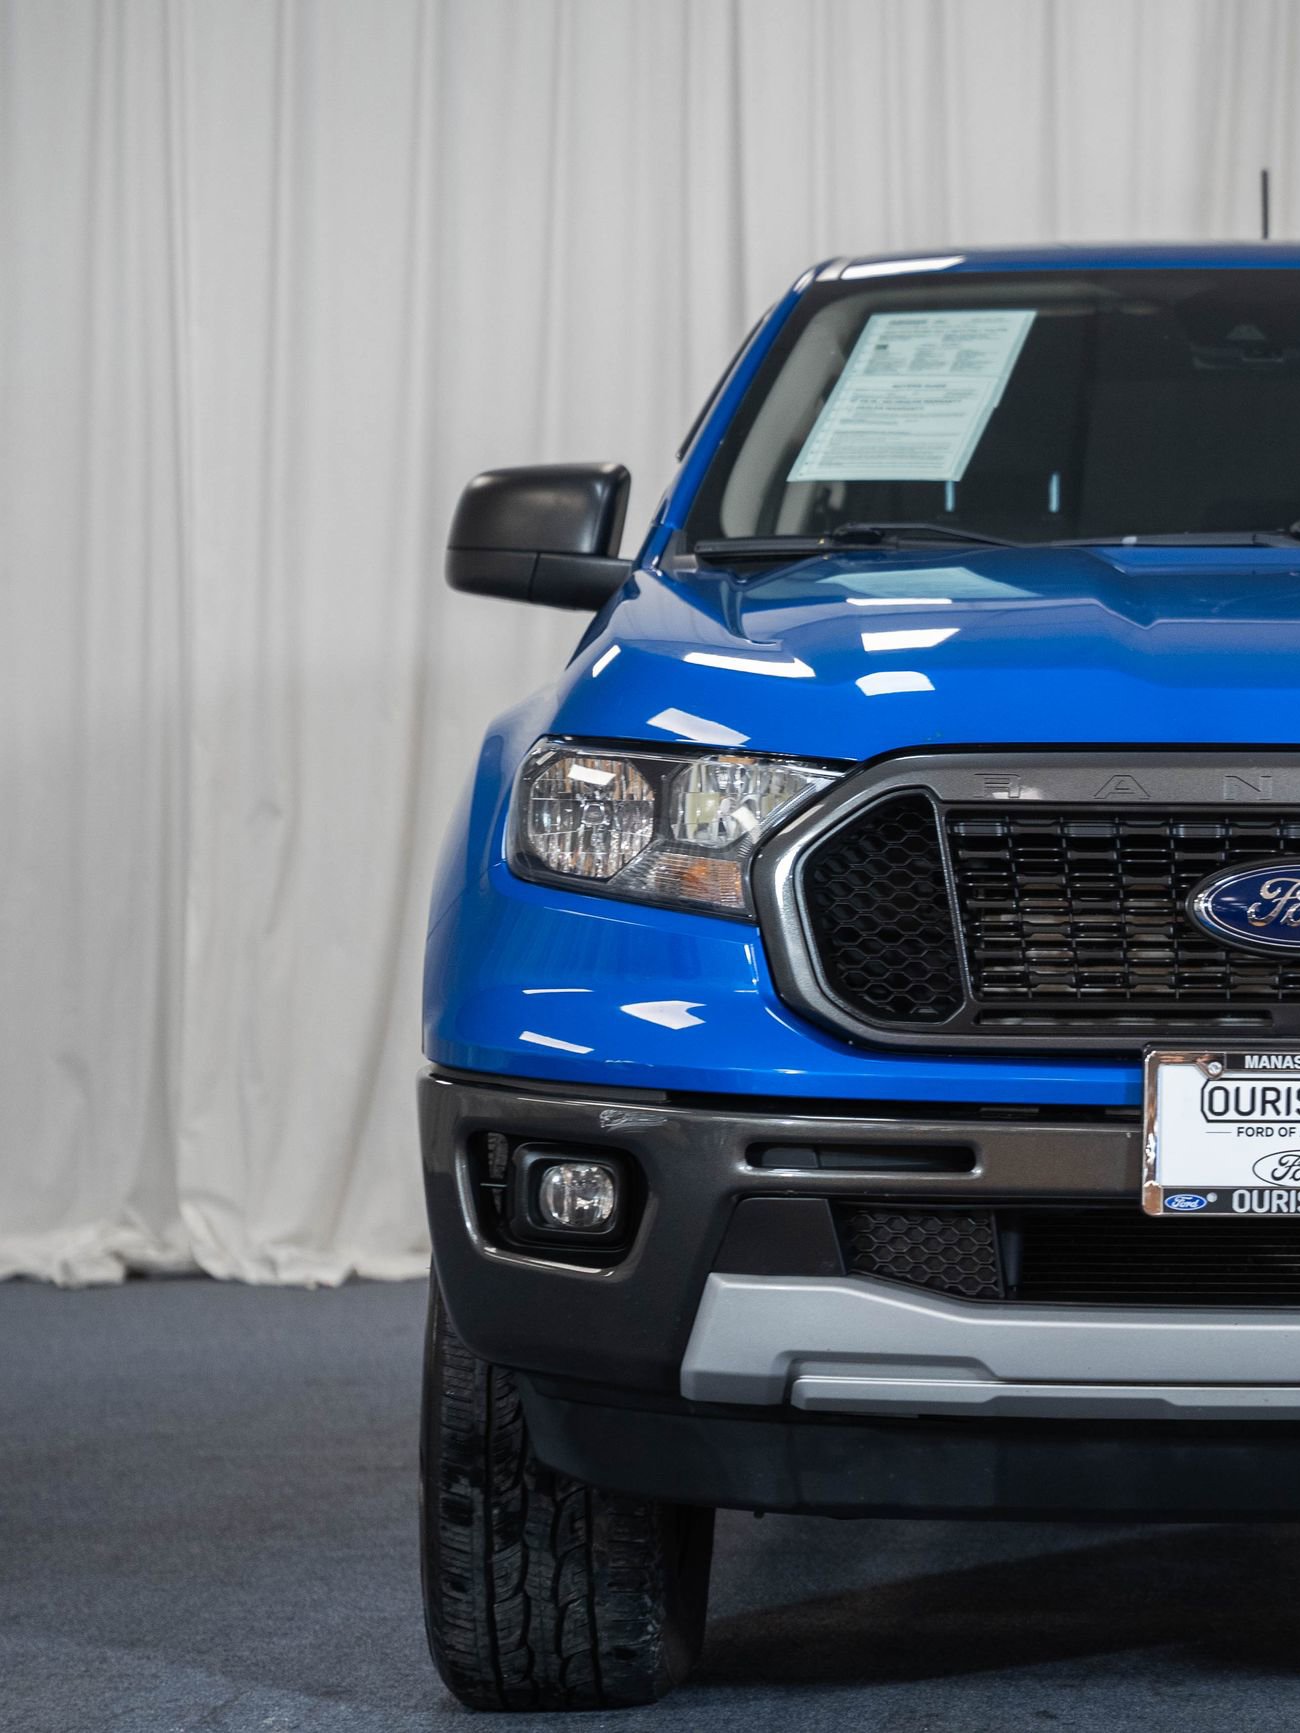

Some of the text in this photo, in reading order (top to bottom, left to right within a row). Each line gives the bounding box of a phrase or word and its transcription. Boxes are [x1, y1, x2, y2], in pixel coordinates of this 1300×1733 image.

[1236, 1126, 1275, 1138] FORD
[1277, 1126, 1297, 1138] OF
[1171, 1196, 1200, 1208] Ford
